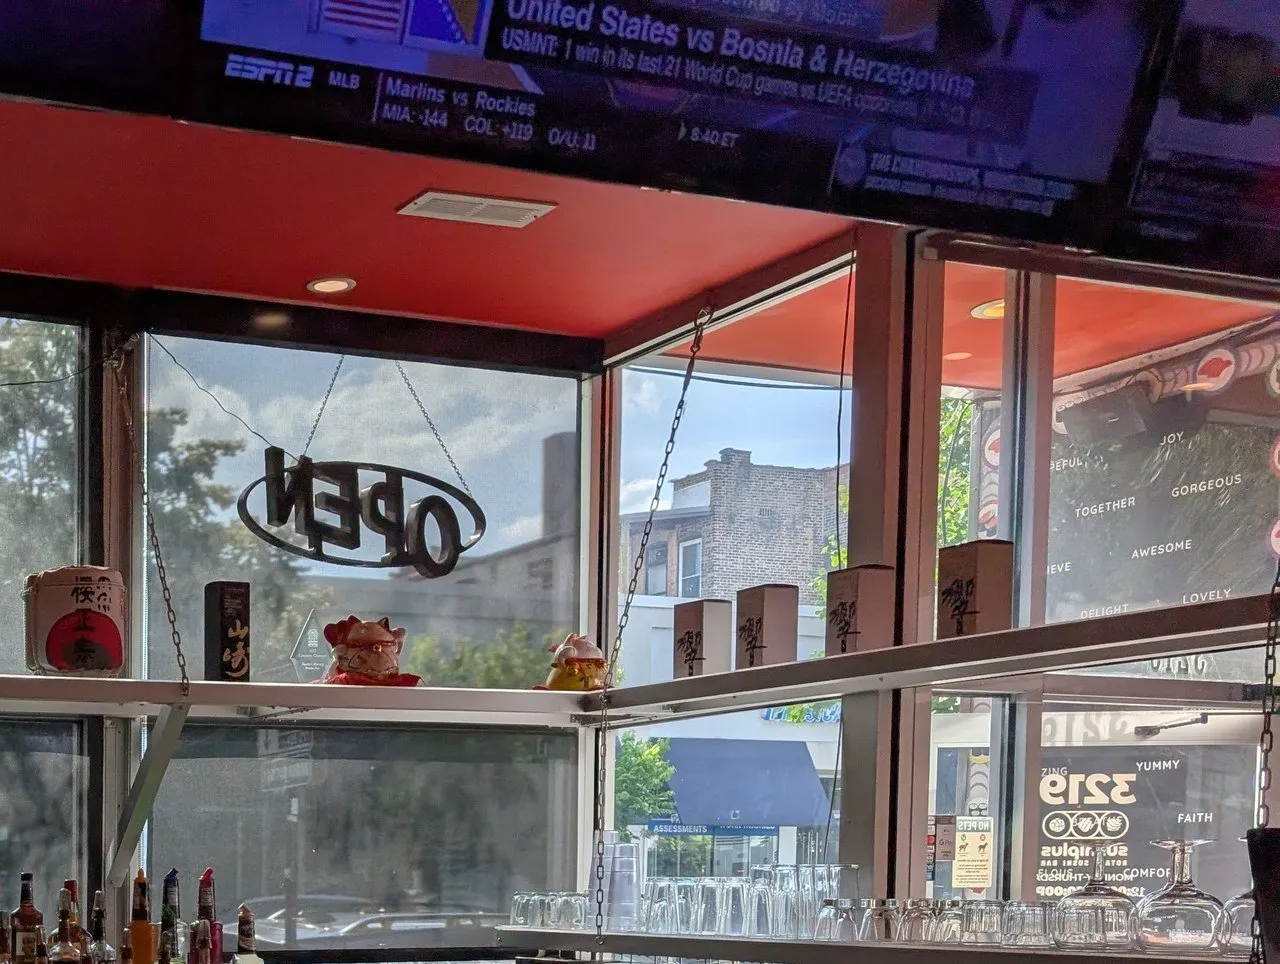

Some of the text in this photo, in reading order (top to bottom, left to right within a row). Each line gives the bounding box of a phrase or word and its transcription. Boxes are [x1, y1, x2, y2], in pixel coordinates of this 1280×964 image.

[507, 0, 595, 31] United
[599, 5, 680, 47] States
[687, 27, 715, 53] vs
[721, 27, 804, 70] Bosnia
[809, 44, 828, 73] &
[328, 70, 360, 91] MLB
[386, 77, 536, 118] Marlins vs Rockies
[382, 102, 415, 123] MIA:
[1160, 431, 1184, 447] JOY
[1171, 473, 1242, 498] GORGEOUS
[1075, 496, 1136, 518] TOGETHER
[1131, 539, 1193, 559] AWESOME
[1182, 588, 1232, 604] LOVELY
[1080, 603, 1129, 619] DELIGHT
[1136, 760, 1180, 771] YUMMY
[1177, 812, 1213, 824] FAITH
[653, 825, 707, 833] ASSESSMENTS
